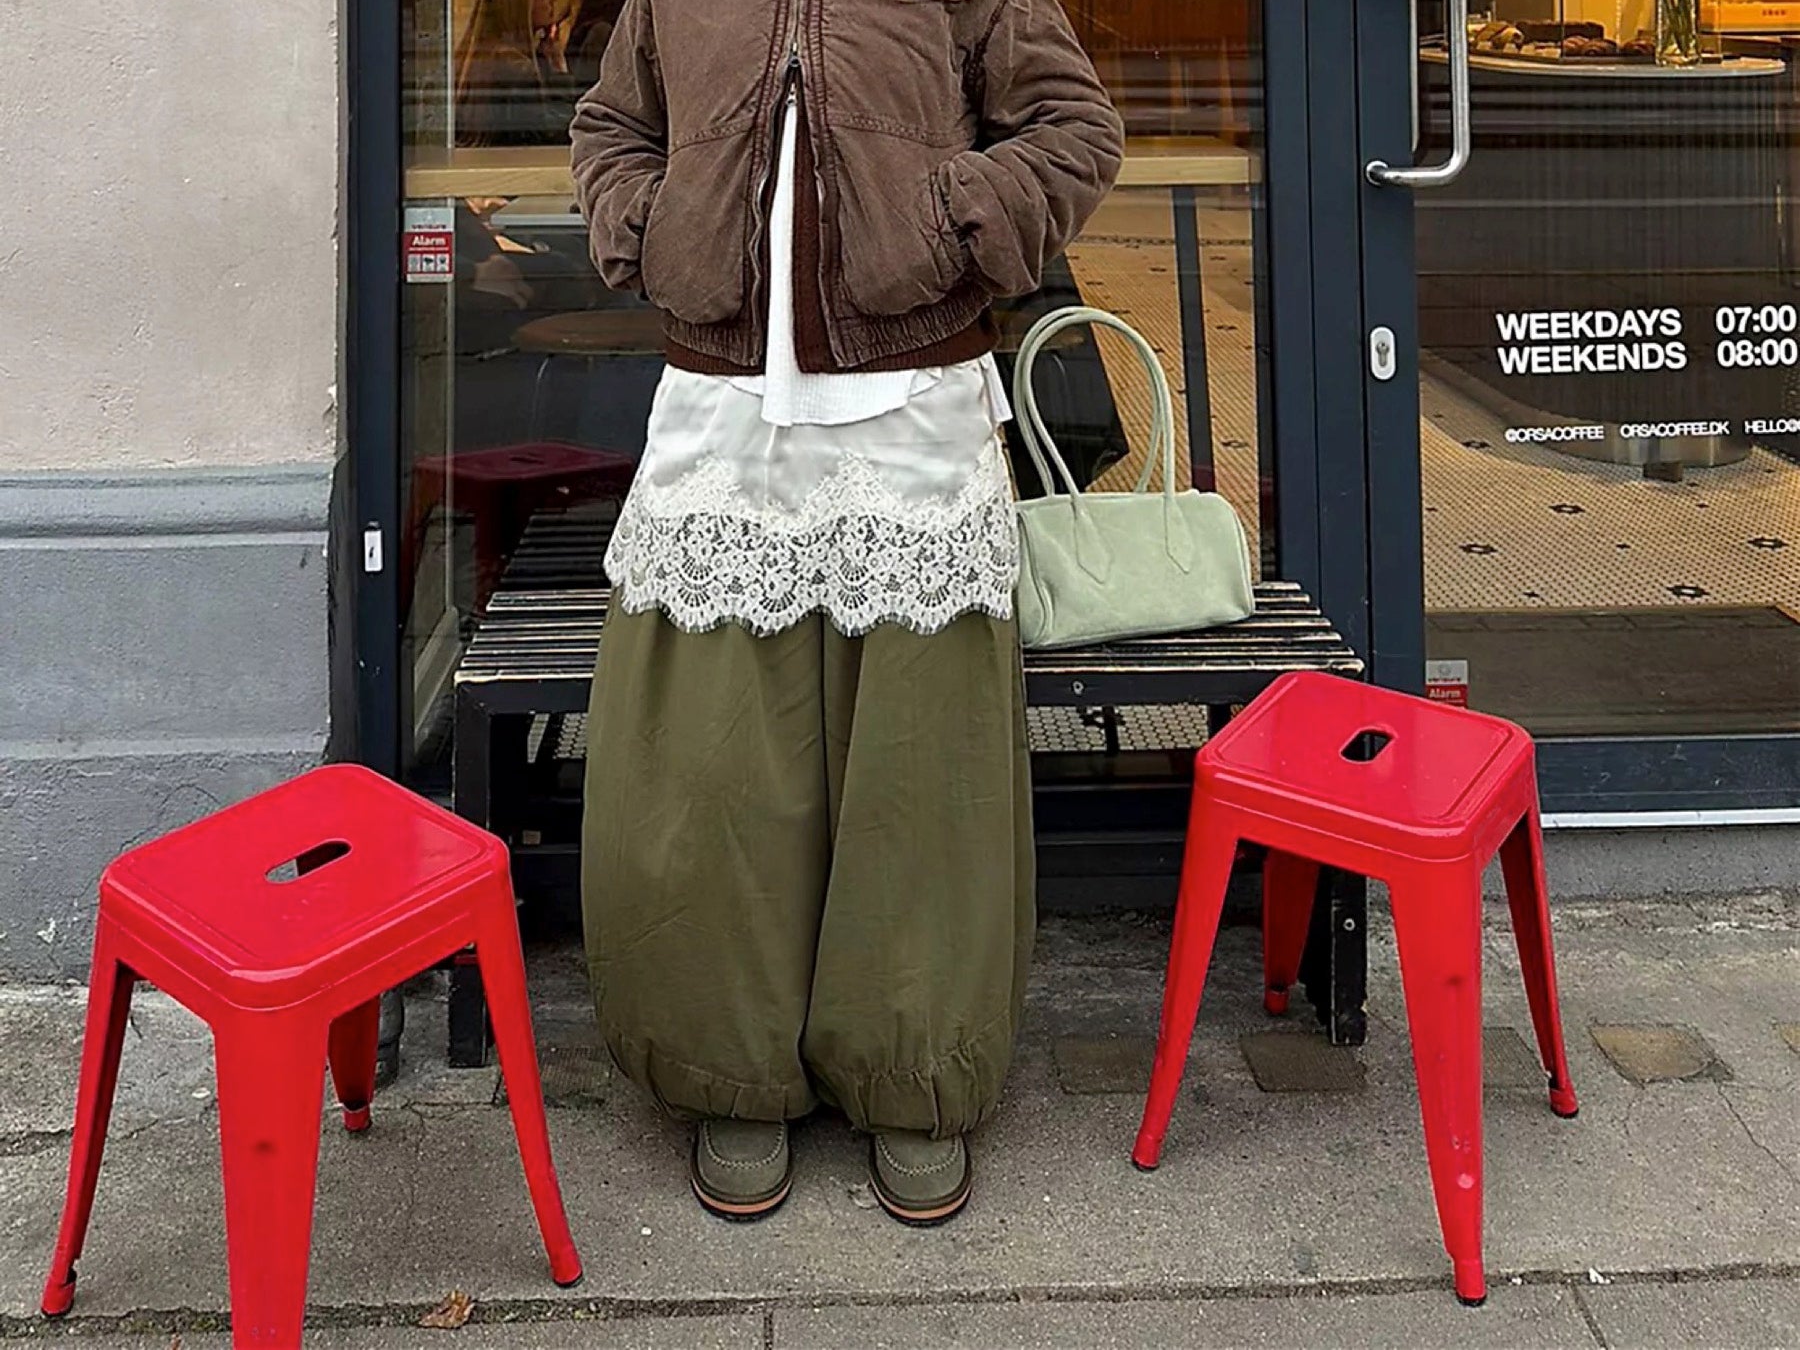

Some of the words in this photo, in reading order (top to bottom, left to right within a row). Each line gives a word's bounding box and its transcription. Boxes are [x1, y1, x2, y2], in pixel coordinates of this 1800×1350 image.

[413, 236, 446, 247] Alarm
[1496, 308, 1682, 341] WEEKDAYS
[1715, 305, 1797, 334] 07:00
[1498, 342, 1687, 374] WEEKENDS
[1716, 338, 1798, 367] 08:00
[1504, 425, 1605, 443] @ORSACOFFEE
[1620, 421, 1730, 438] ORSACOFFEE.DK
[1744, 418, 1800, 434] HELLO@
[1430, 689, 1461, 698] Alarm
